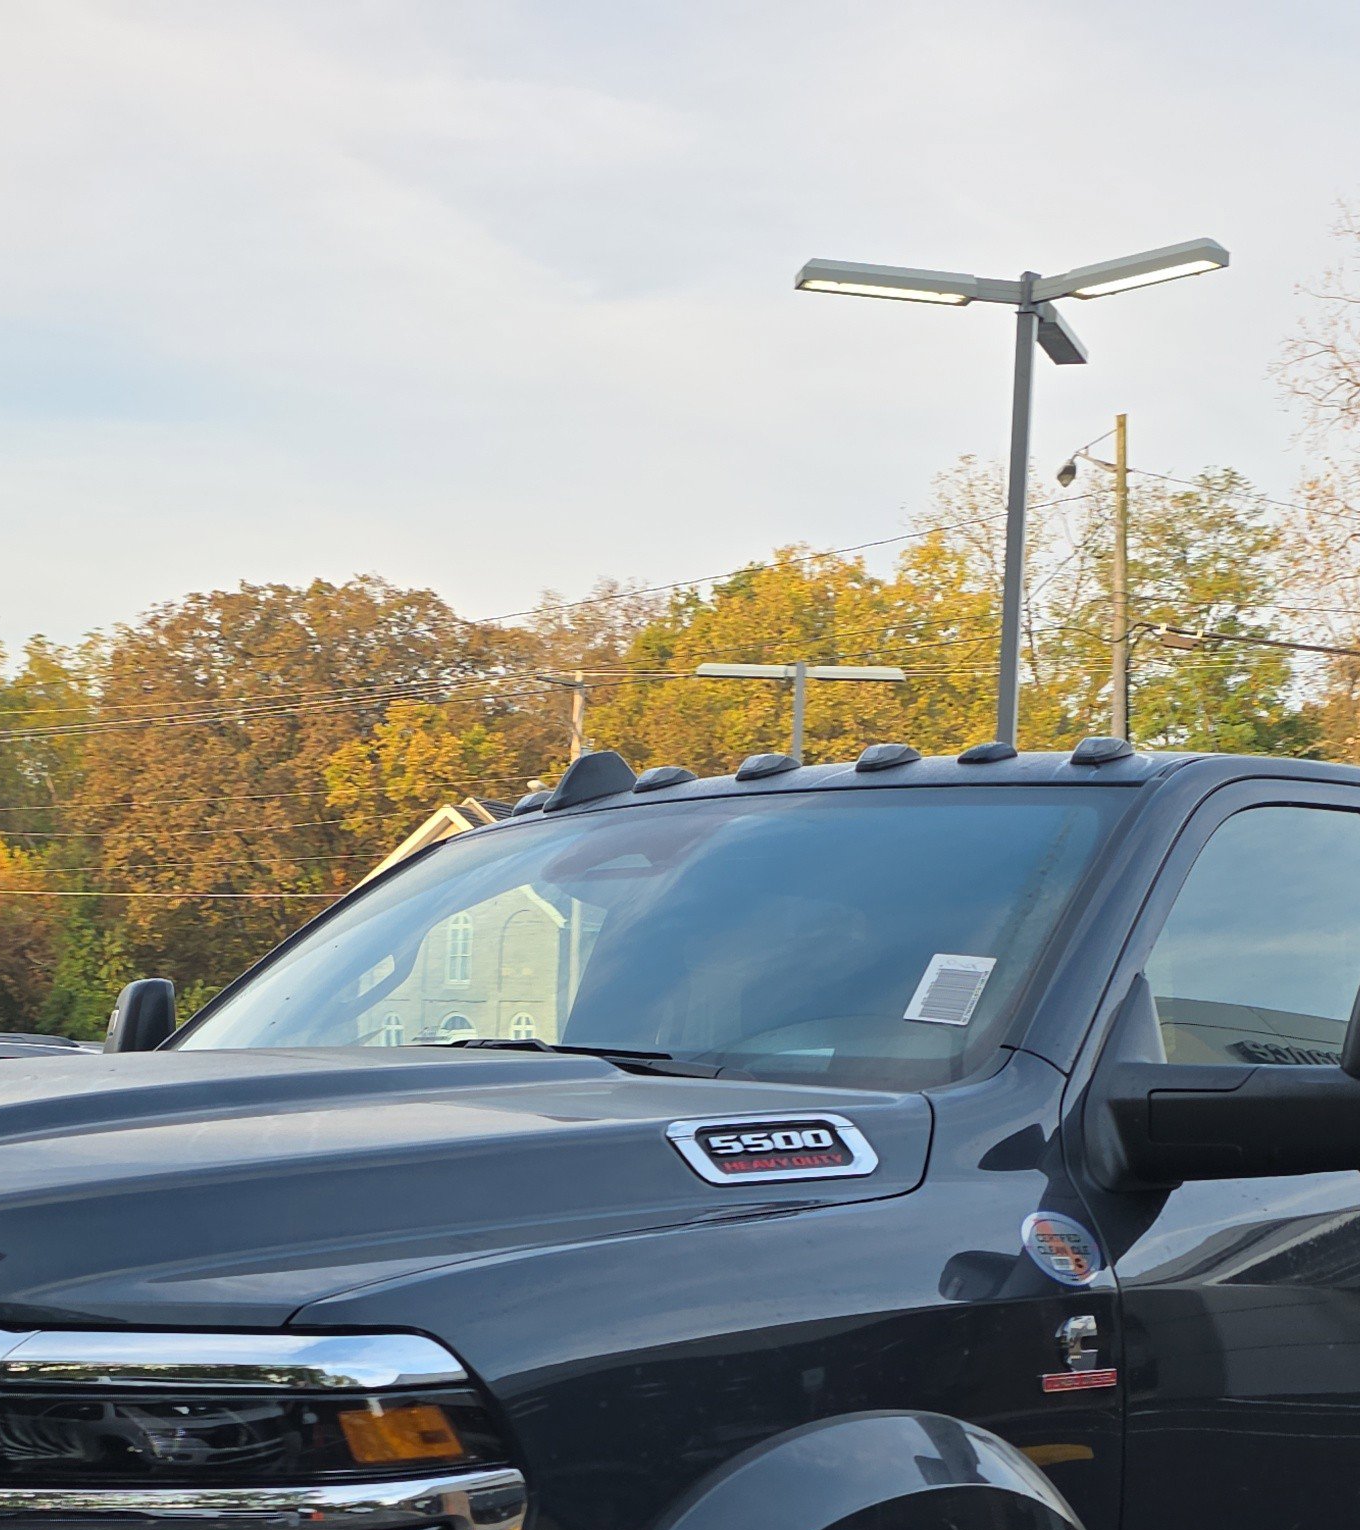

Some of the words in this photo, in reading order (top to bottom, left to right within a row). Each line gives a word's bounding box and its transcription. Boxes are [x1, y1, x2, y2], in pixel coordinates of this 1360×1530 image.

[708, 1129, 834, 1155] 5500
[723, 1157, 788, 1171] HEAVY
[791, 1154, 842, 1166] DUTY
